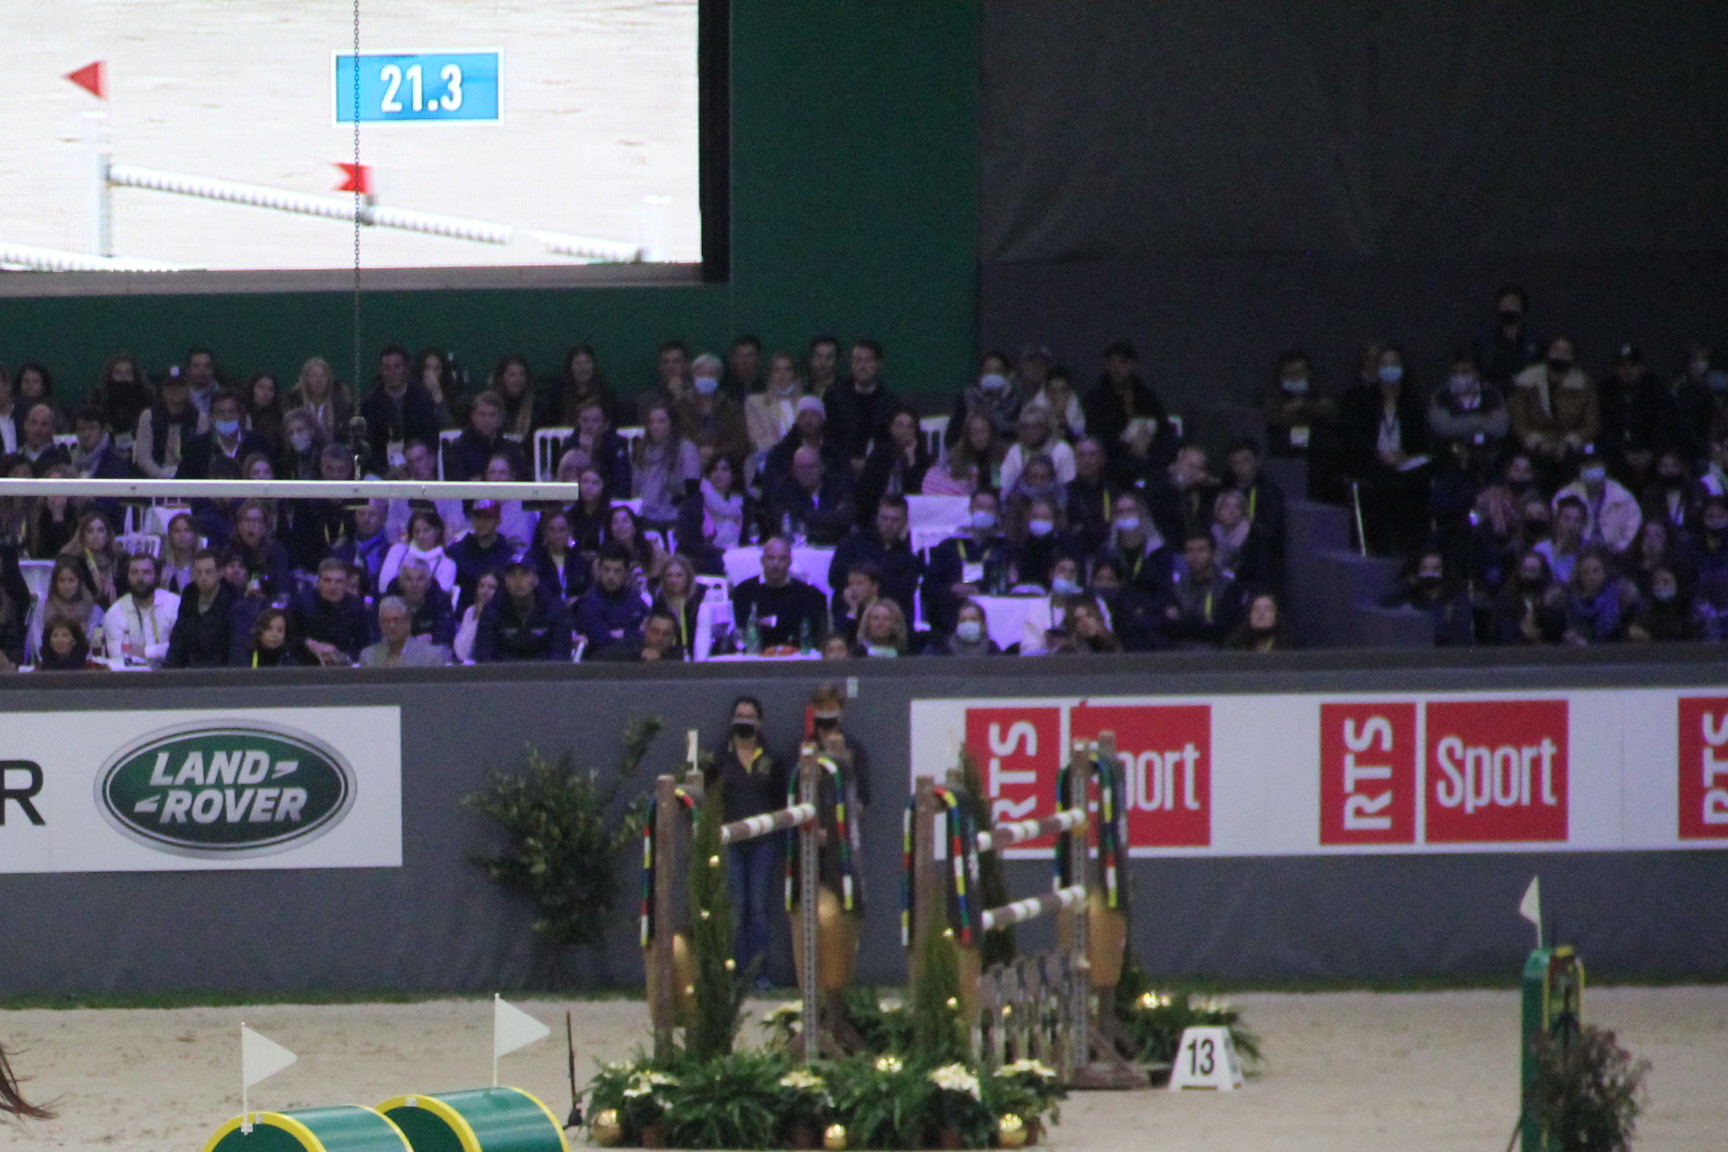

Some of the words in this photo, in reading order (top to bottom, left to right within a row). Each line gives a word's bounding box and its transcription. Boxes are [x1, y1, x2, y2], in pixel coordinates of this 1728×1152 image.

[380, 64, 463, 113] 21.3
[149, 750, 271, 786] LAND
[1343, 714, 1393, 831] RTS
[1436, 734, 1558, 814] Sport
[158, 787, 308, 825] ROVER
[1186, 1038, 1214, 1076] 13
